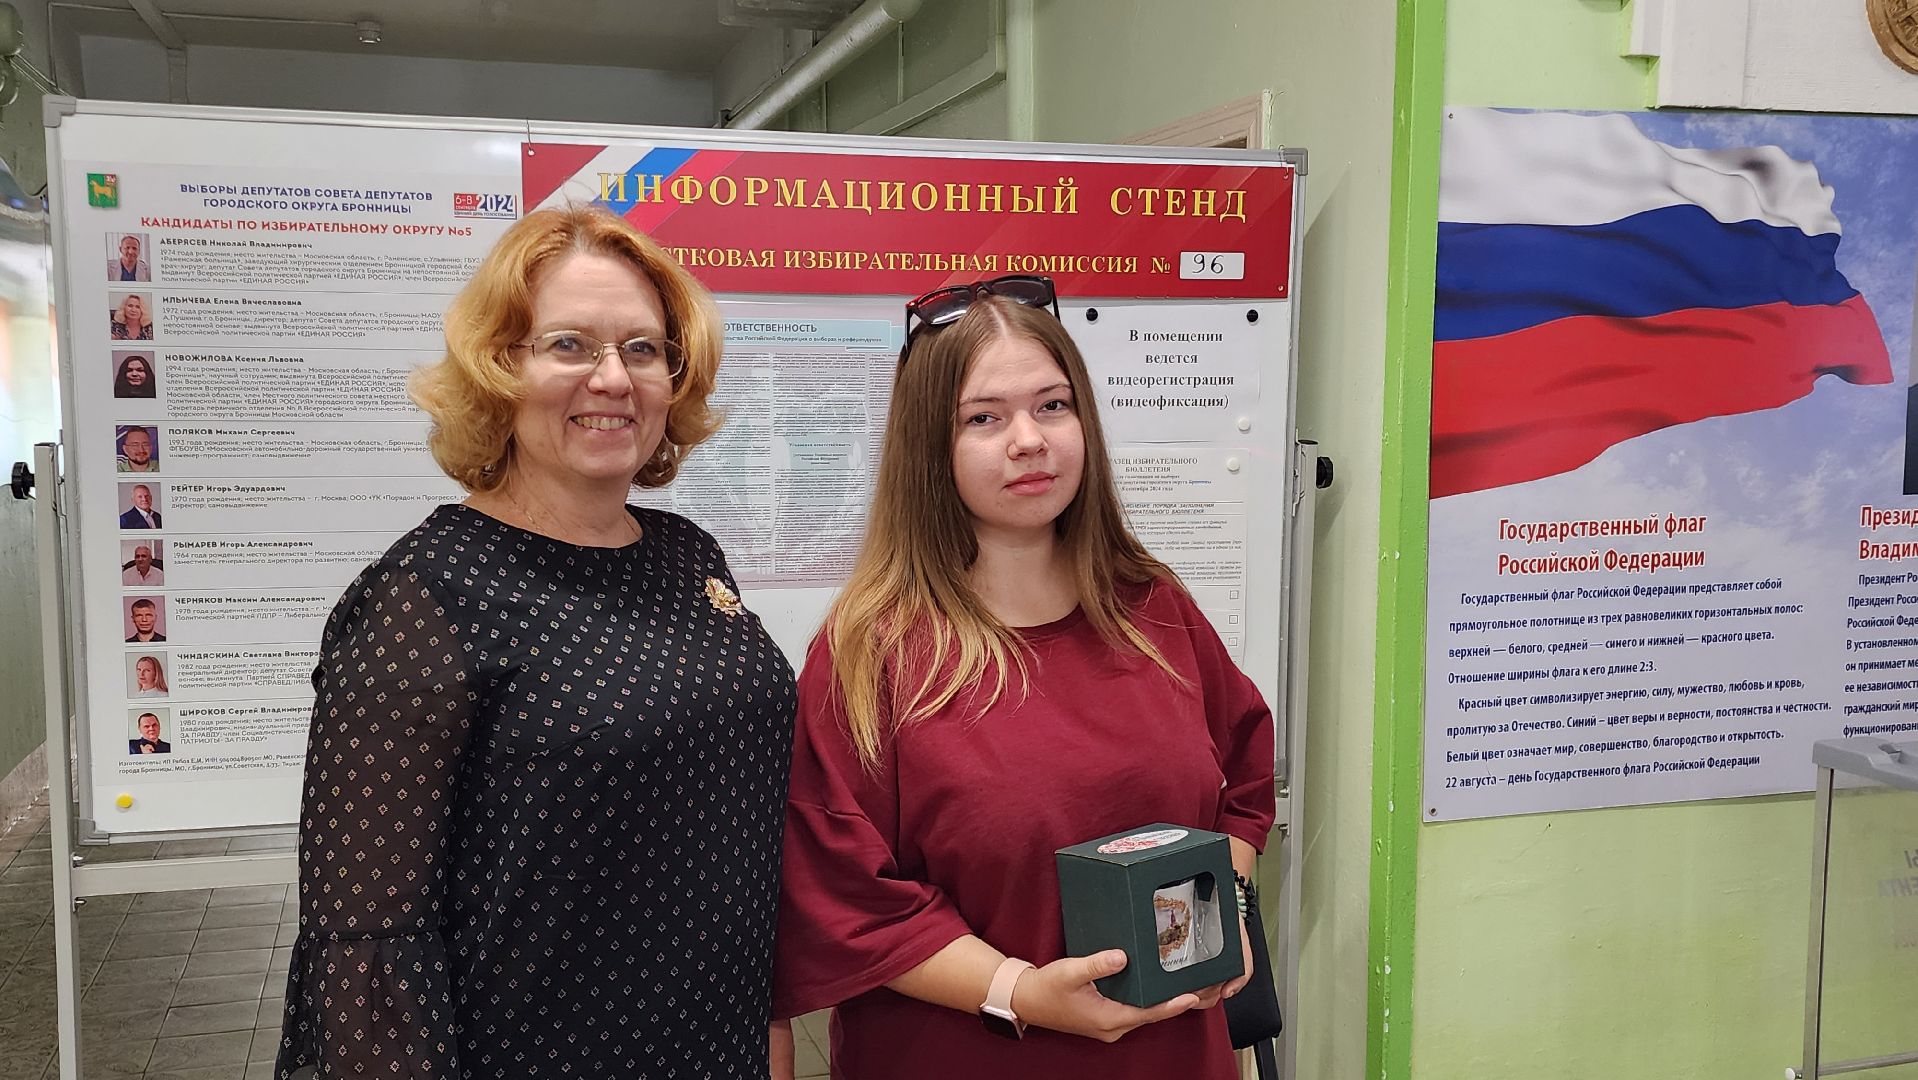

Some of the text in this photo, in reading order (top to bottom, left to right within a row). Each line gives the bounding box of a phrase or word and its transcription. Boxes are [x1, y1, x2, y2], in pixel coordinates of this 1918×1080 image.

[181, 184, 432, 201] ВЫБОРЫ ДЕПУТАТОВ СОВЕТА ДЕПУТАТОВ
[597, 172, 1248, 224] ИНФОРМАЦИОННЫЙ СТЕНД
[203, 199, 411, 214] ГОРОДСКОГО ОКРУГА БРОННИЦЫ
[476, 194, 514, 212] 2024
[141, 217, 232, 230] КАНДИДАТЫ
[237, 220, 256, 230] ПО
[262, 222, 388, 234] ИЗБИРАТЕЛЬНОМУ
[393, 225, 444, 236] ОКРУГУ
[160, 238, 207, 246] АБЕРЯСЕВ
[250, 241, 312, 249] Владимирович
[783, 250, 997, 272] ИЗБИРАТЕЛЬНАЯ
[1006, 254, 1138, 274] КОМИССИЯ
[1151, 257, 1171, 274] №
[1192, 254, 1224, 275] 96
[162, 296, 211, 304] ИЛЬИЧЕВА
[724, 322, 817, 333] ОТВЕТСТВЕННОСТЬ
[1129, 330, 1223, 342] В помещении
[1145, 354, 1198, 364] ведется
[1108, 376, 1234, 388] видеорегистрация
[1111, 395, 1229, 410] (видеофиксация)
[250, 429, 295, 437] Сергеевич
[171, 484, 204, 492] РЕЙТЕР
[1500, 513, 1706, 543] Государственный флаг
[1499, 550, 1705, 574] Российской Федерации
[1859, 574, 1906, 586] Президент
[1461, 578, 1782, 606] Государственный флаг Российской Федерации представляет собой
[260, 596, 326, 604] Александрович
[1848, 596, 1894, 609] Президент
[1449, 604, 1803, 634] прямоугольное полотнище из трех равновеликих горизонтальных полос:
[1847, 616, 1894, 628] Российской
[1449, 645, 1491, 659] верхней
[1509, 642, 1545, 655] белого,
[1548, 639, 1588, 654] средней
[1605, 638, 1637, 649] синего
[1647, 634, 1684, 646] нижней
[1701, 631, 1742, 645] красного
[1745, 631, 1774, 642] цвета.
[1846, 640, 1852, 650] В
[1449, 661, 1656, 685] Отношение ширины флага к его длине 2:3.
[1858, 660, 1906, 672] принимает
[1459, 696, 1501, 710] Красный
[1504, 695, 1527, 708] цвет
[1530, 690, 1604, 705] символизирует
[1606, 687, 1650, 700] энергию,
[1652, 686, 1674, 699] силу,
[1677, 683, 1726, 696] мужество,
[1728, 680, 1764, 692] любовь
[1774, 678, 1805, 690] кровь,
[1845, 684, 1854, 692] ее
[180, 708, 226, 717] ШИРОКОВ
[229, 707, 258, 716] Сергей
[1844, 702, 1900, 716] гражданский
[1447, 724, 1496, 738] пролитую
[1499, 724, 1509, 733] за
[1512, 718, 1565, 732] Отечество.
[1567, 716, 1596, 728] Синий
[1607, 714, 1629, 726] цвет
[1632, 713, 1657, 725] веры
[1659, 712, 1665, 721] и
[1668, 709, 1714, 723] верности,
[1716, 704, 1773, 718] постоянства
[1783, 702, 1832, 712] честности.
[1447, 730, 1784, 763] Белый цвет означает мир, совершенство, благородство и открытость.
[1446, 755, 1760, 788] 22 августа день Государственного флага Российской Федерации
